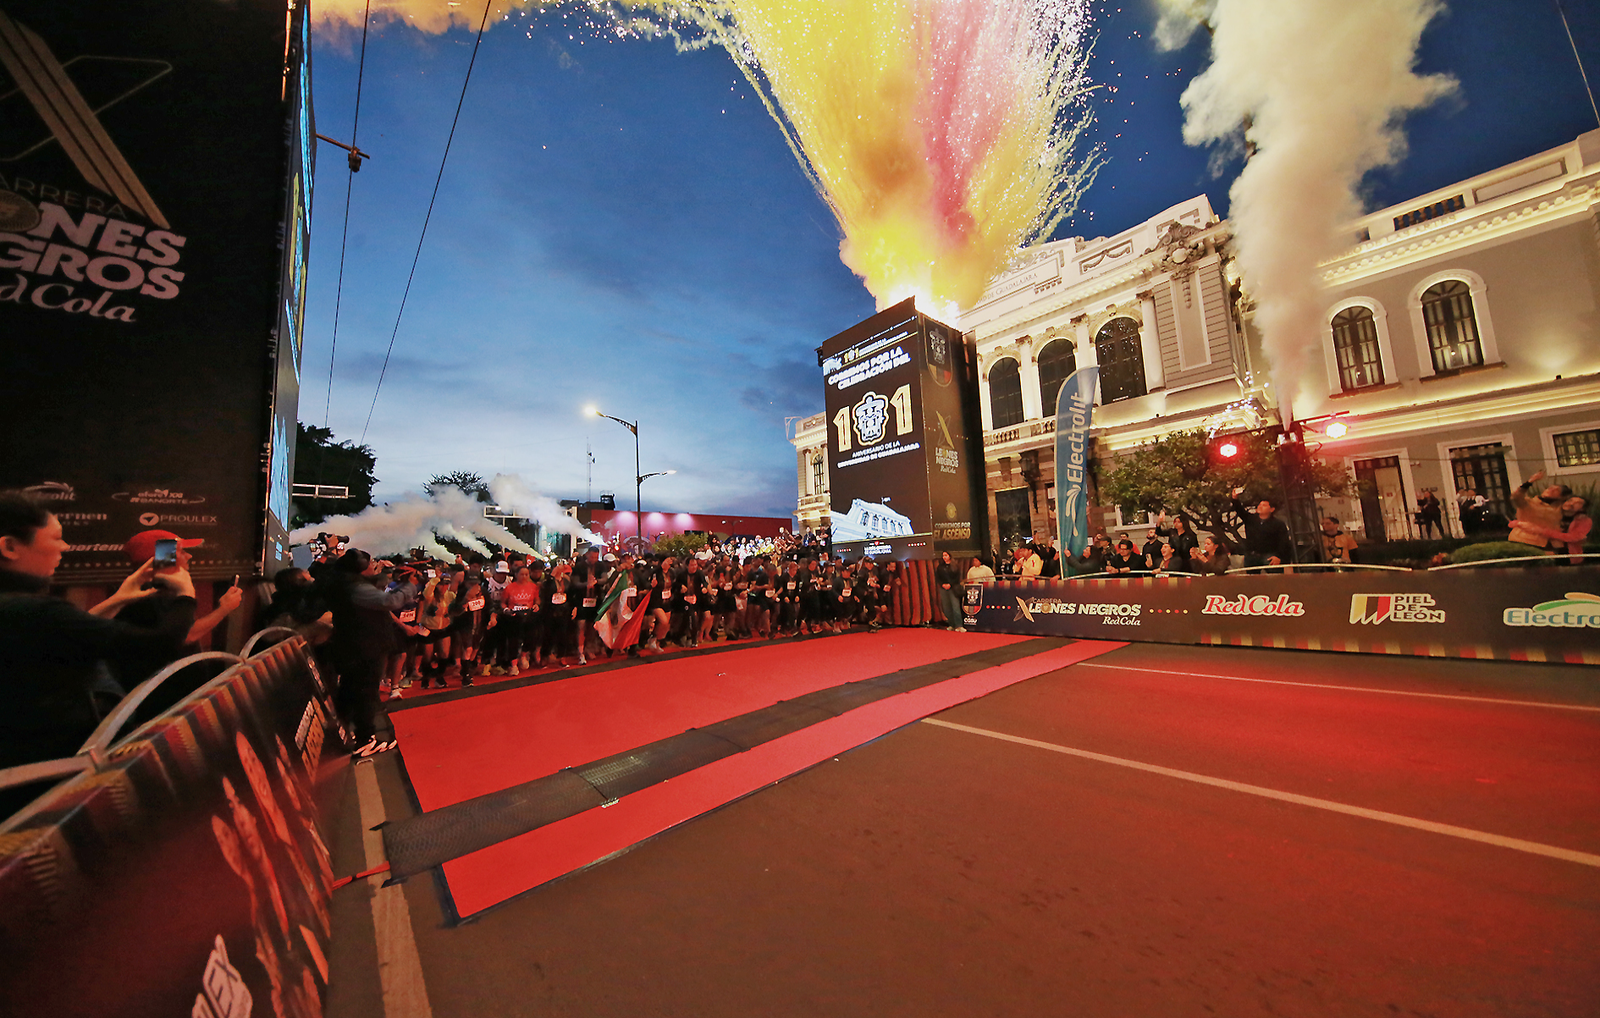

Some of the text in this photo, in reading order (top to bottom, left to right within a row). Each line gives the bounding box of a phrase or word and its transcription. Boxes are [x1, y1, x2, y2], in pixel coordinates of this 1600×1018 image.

[871, 351, 890, 367] POR
[890, 346, 904, 358] LA
[1066, 392, 1087, 483] Electrolit
[160, 514, 218, 523] PROULEX
[1395, 596, 1432, 604] PIEL
[1078, 603, 1141, 616] NEGROS
[1393, 608, 1442, 620] LEÓN
[1507, 610, 1600, 626] Electro
